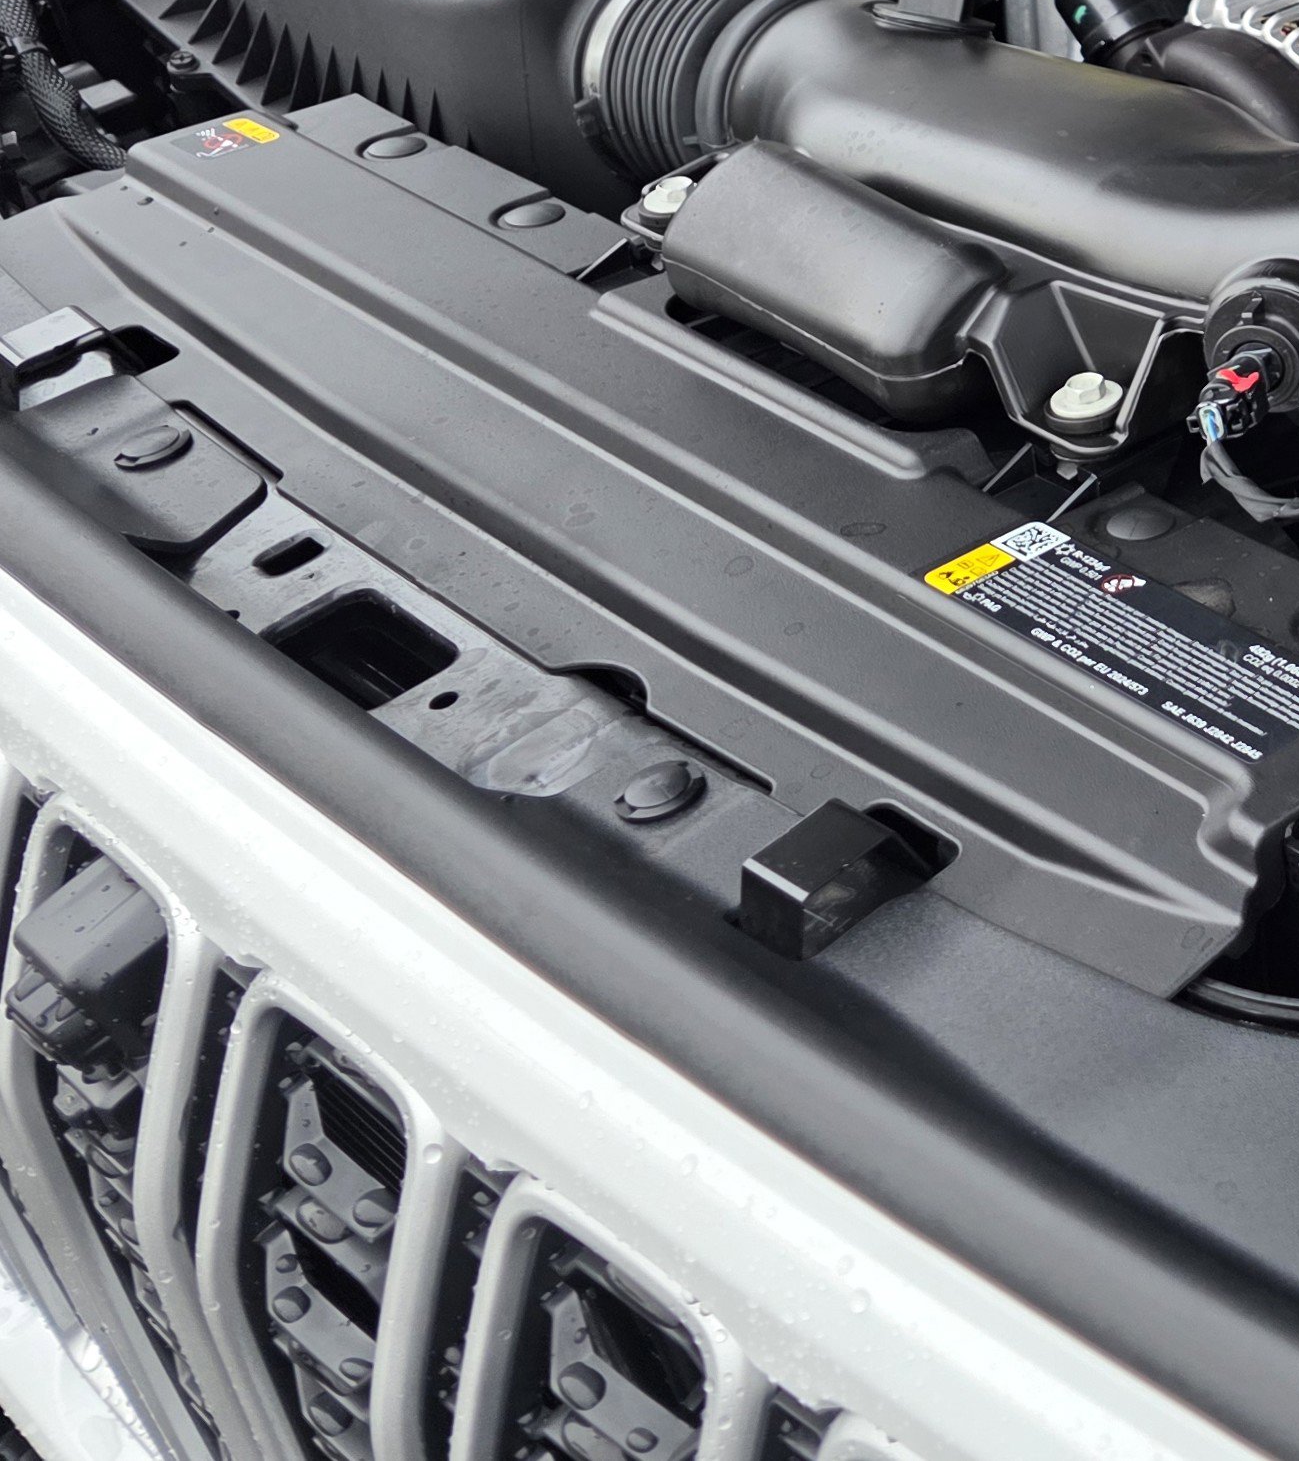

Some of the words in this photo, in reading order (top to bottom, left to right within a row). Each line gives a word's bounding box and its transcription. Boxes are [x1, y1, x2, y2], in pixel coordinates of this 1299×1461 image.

[1060, 643, 1083, 657] CO2
[1093, 662, 1112, 675] EU
[1243, 654, 1265, 668] CO2
[1161, 701, 1186, 717] SAE
